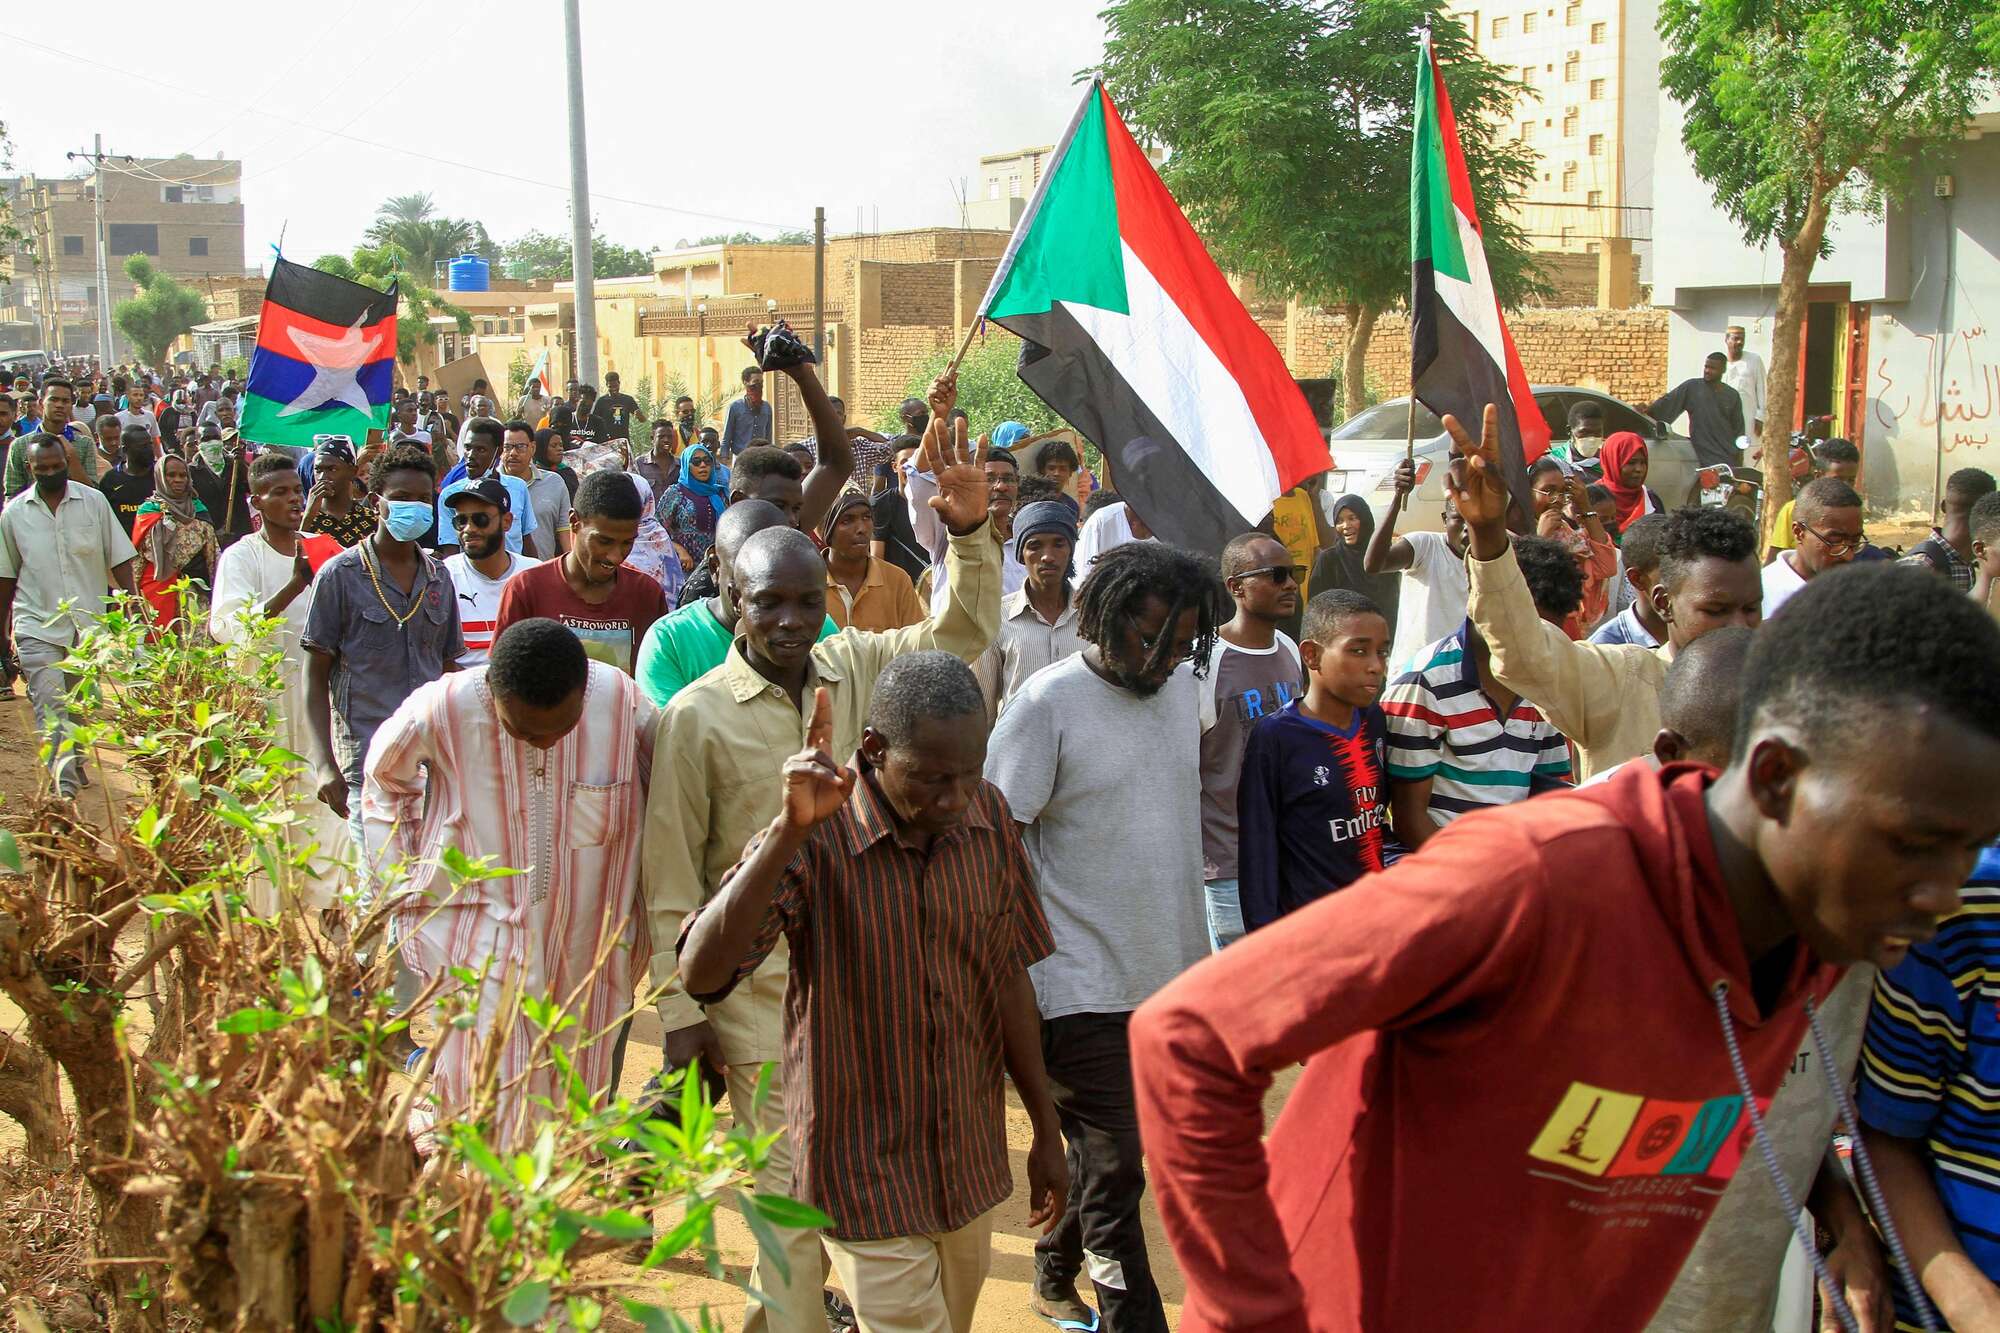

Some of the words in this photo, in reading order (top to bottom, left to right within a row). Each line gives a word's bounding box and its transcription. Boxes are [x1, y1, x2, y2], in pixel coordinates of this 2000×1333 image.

[120, 504, 137, 513] Plu
[563, 618, 629, 631] ASTROWORLD
[1232, 679, 1300, 720] TRAN
[1608, 1178, 1692, 1198] CLASSIC
